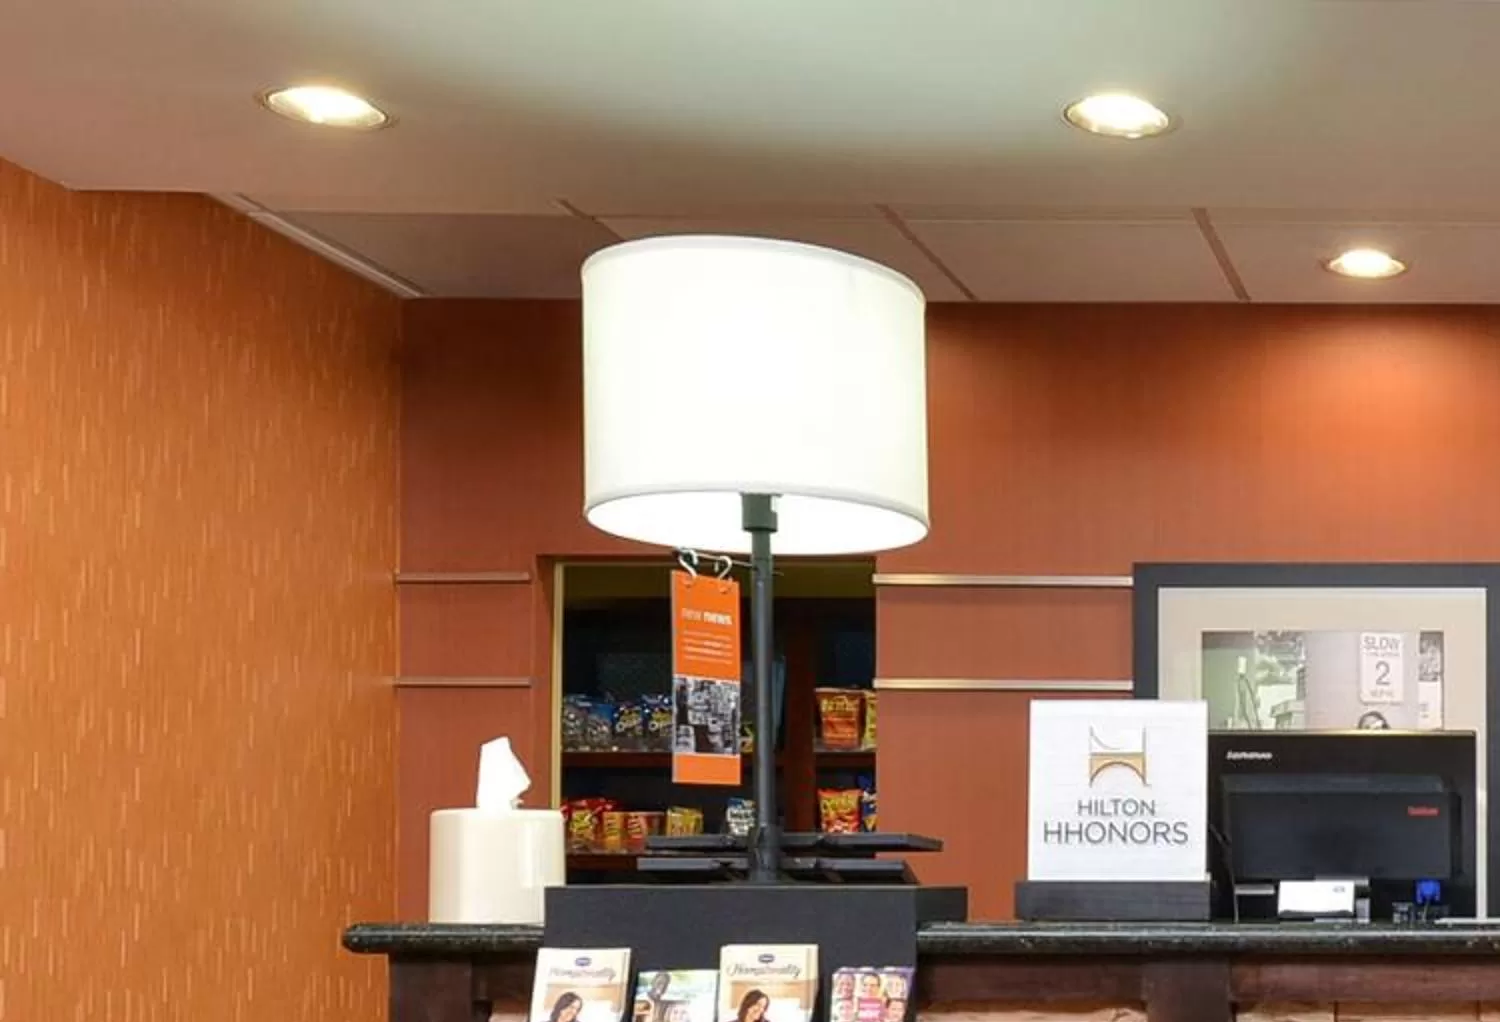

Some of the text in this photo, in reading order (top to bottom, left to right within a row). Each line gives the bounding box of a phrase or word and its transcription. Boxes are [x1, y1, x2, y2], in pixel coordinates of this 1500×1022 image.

[1375, 661, 1391, 685] 2
[1077, 798, 1156, 816] HILTON
[1043, 821, 1189, 844] HHONORS
